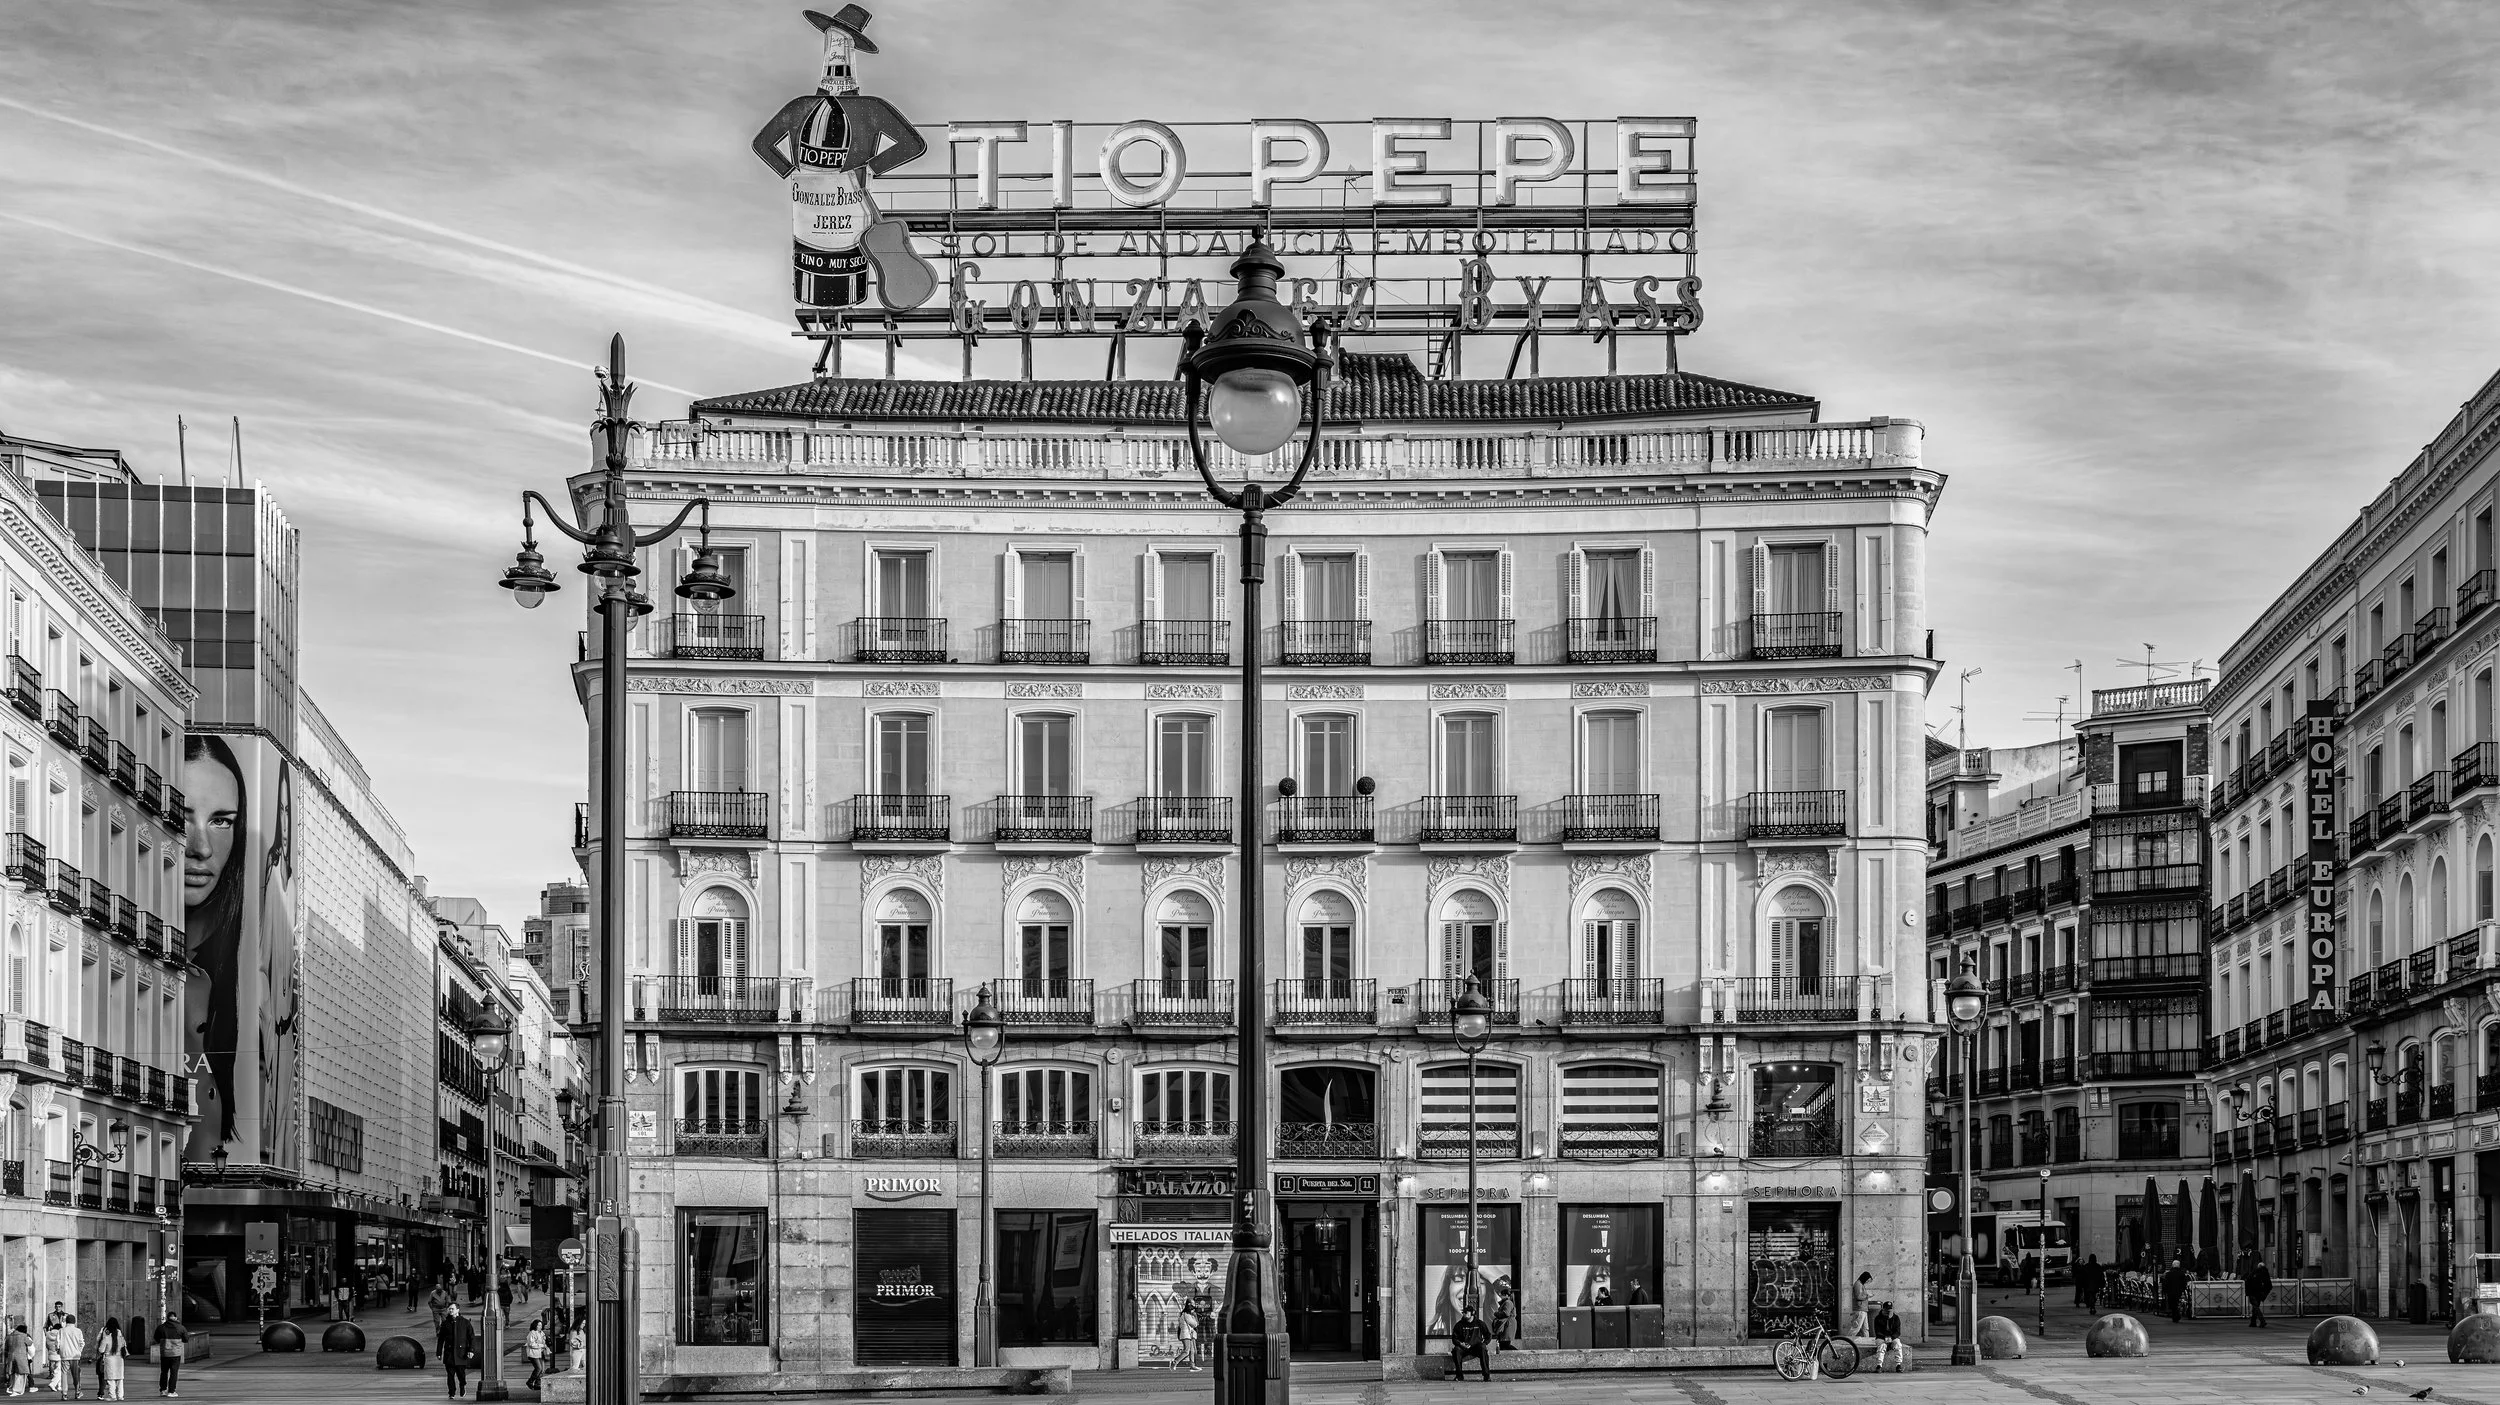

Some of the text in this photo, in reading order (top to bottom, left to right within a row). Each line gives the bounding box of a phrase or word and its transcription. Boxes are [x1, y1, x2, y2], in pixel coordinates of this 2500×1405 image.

[800, 147, 818, 163] TIO
[949, 116, 1697, 209] TIO PEPE
[792, 182, 862, 206] GONZALEZ BYASS
[813, 215, 852, 229] JEREZ
[940, 231, 1025, 257] SOL
[1044, 231, 1095, 256] DE
[1377, 228, 1695, 254] EMBOTELLADO
[801, 253, 866, 268] FINO MUY SECO
[949, 257, 1704, 333] GONZAEZ BYASS
[2309, 716, 2334, 840] HOTEL
[2310, 860, 2335, 1011] EUROPA
[865, 1177, 941, 1192] PRIMOR
[1145, 1181, 1227, 1195] PALAZZO
[1283, 1180, 1291, 1188] 11
[1363, 1180, 1371, 1188] 11
[1753, 1186, 1838, 1197] SEPHORA
[1427, 1187, 1511, 1199] SEPHORA
[1116, 1231, 1178, 1241] HELADOS
[876, 1284, 936, 1296] PRIMOR
